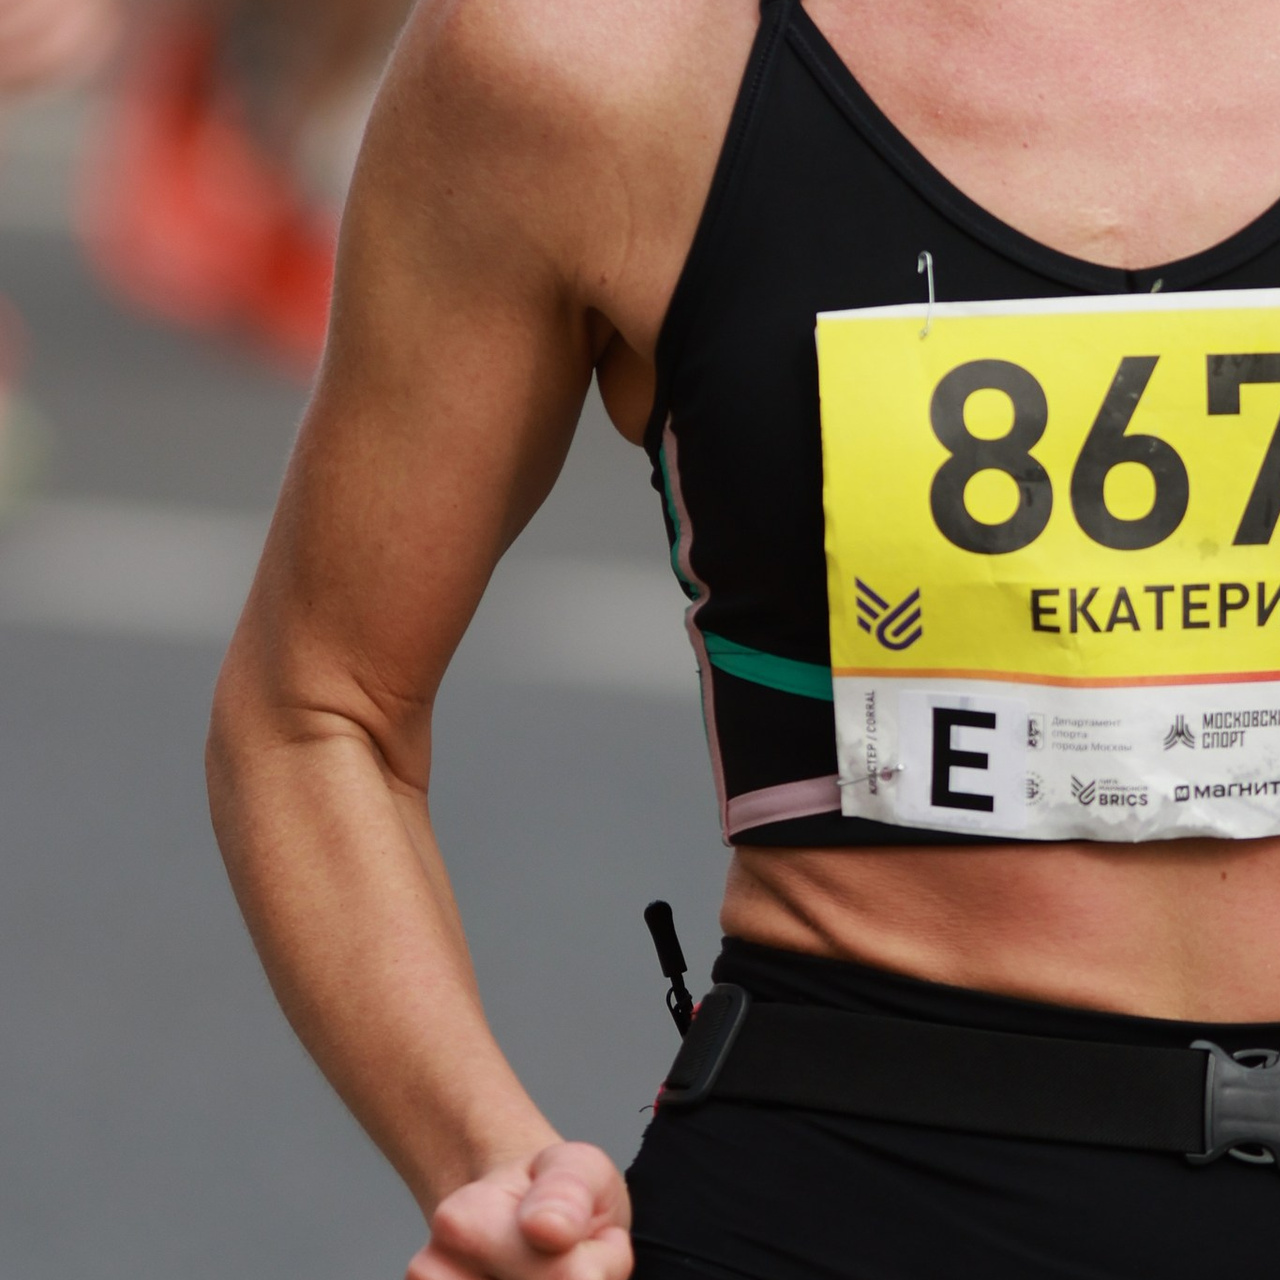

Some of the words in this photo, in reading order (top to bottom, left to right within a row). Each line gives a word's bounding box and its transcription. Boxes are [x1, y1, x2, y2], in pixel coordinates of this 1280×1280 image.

[865, 690, 877, 733] CORRAL
[1051, 730, 1088, 740] спорта
[1202, 730, 1246, 749] СПОРТ
[1051, 742, 1088, 752] города
[1099, 794, 1149, 806] BRICS
